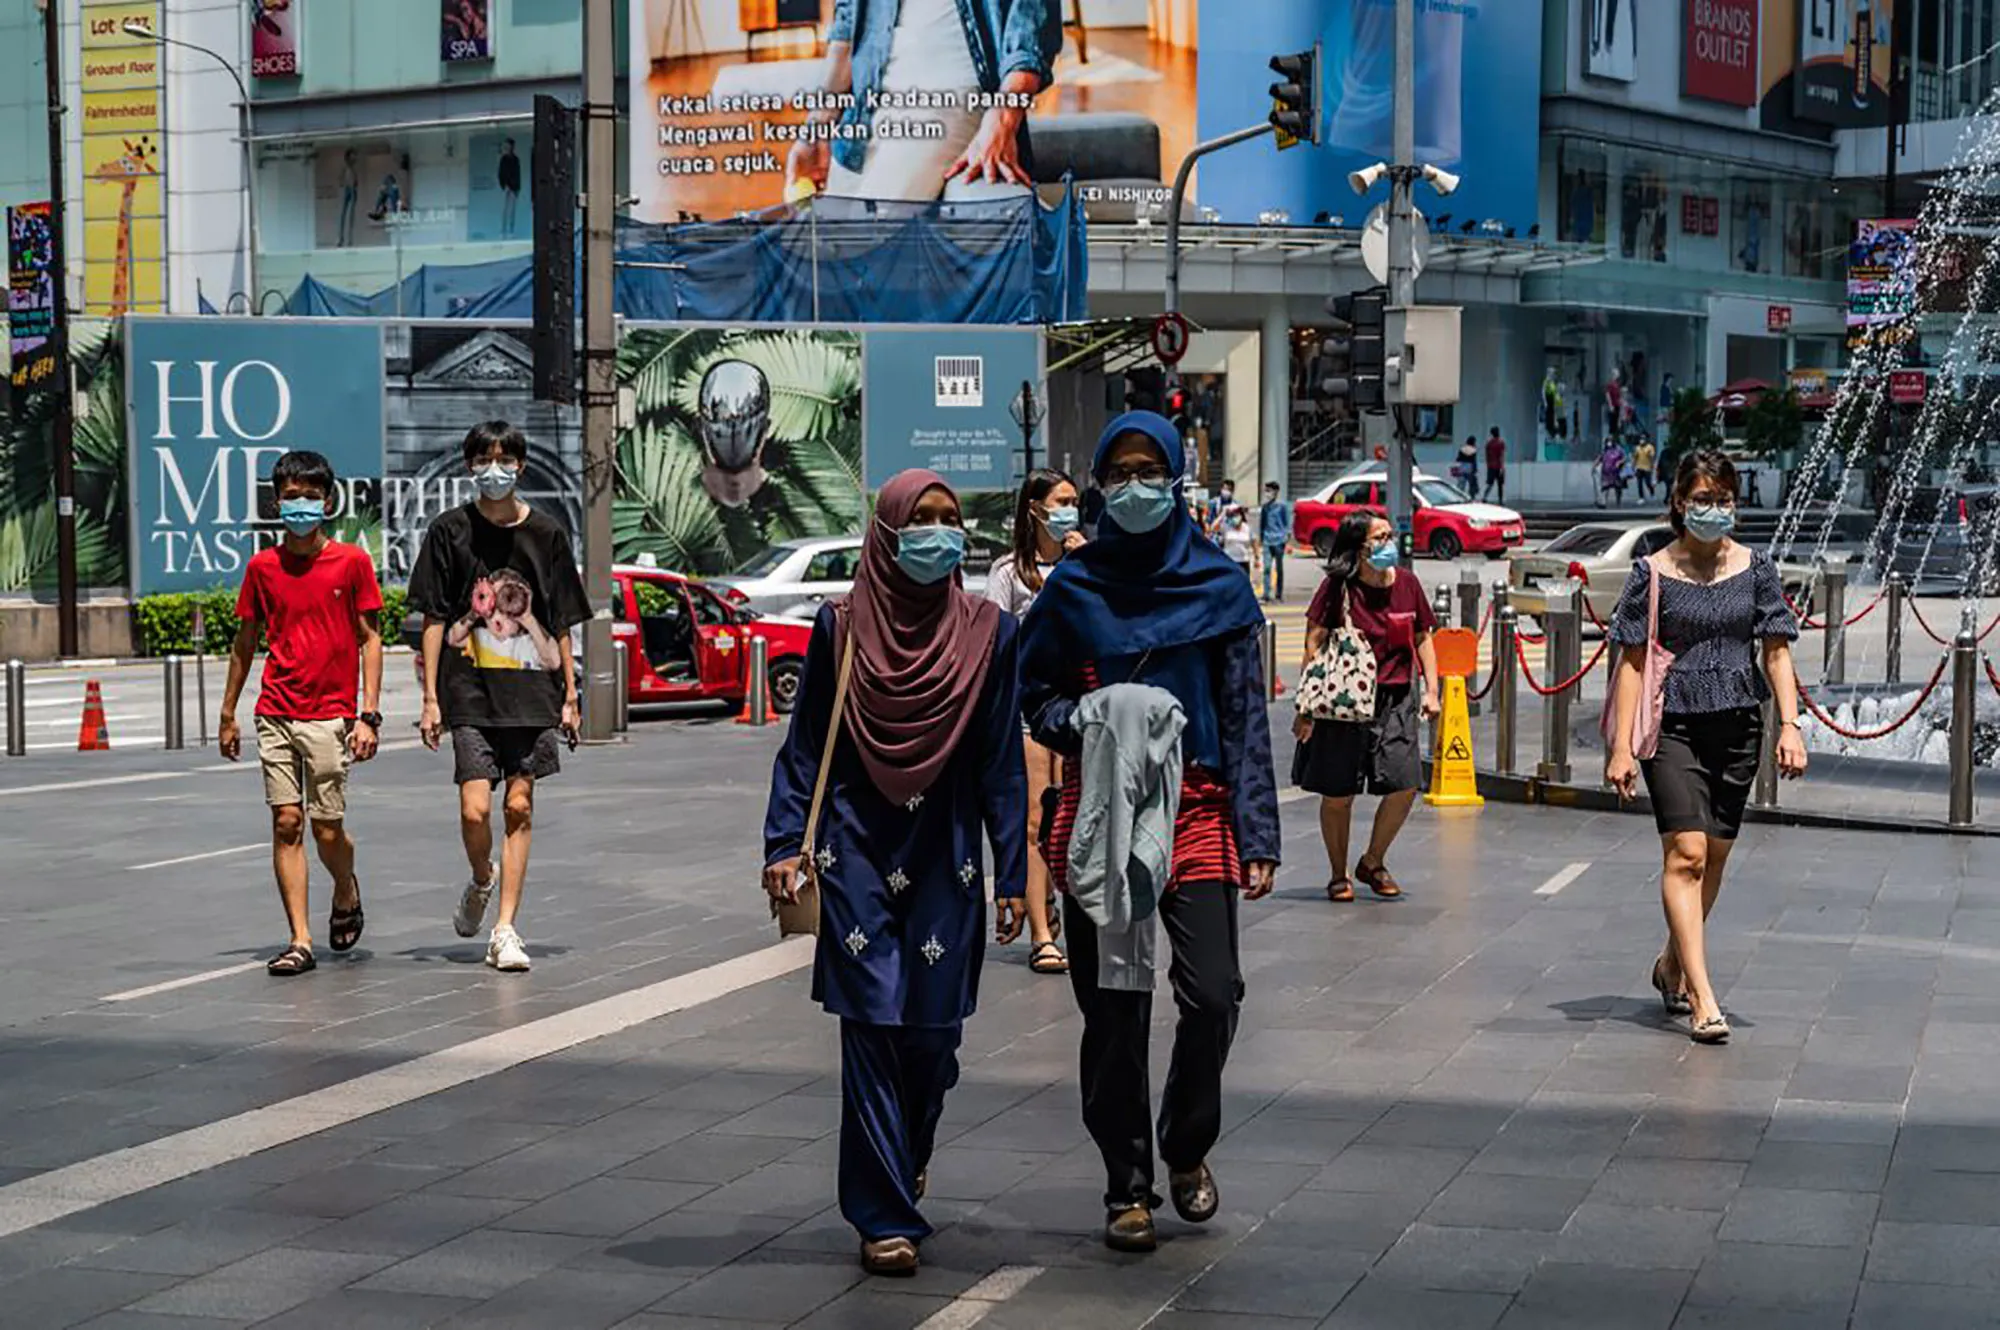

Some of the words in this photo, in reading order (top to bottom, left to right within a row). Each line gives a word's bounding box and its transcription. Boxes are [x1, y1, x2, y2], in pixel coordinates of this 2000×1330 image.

[91, 19, 115, 35] Lot
[451, 41, 478, 58] SPA
[1696, 30, 1750, 69] OUTLET
[85, 63, 125, 77] Ground
[253, 55, 294, 74] SHOES
[660, 96, 712, 115] Kekal
[722, 94, 781, 112] selesa
[793, 91, 855, 109] dalam
[867, 89, 956, 108] keadaan
[659, 124, 754, 146] Mengawal
[764, 121, 868, 142] kesejukan
[877, 118, 943, 138] dalam
[659, 156, 714, 175] cuaca
[725, 154, 782, 174] sejuk.
[150, 360, 292, 441] HO
[153, 446, 291, 525] ME
